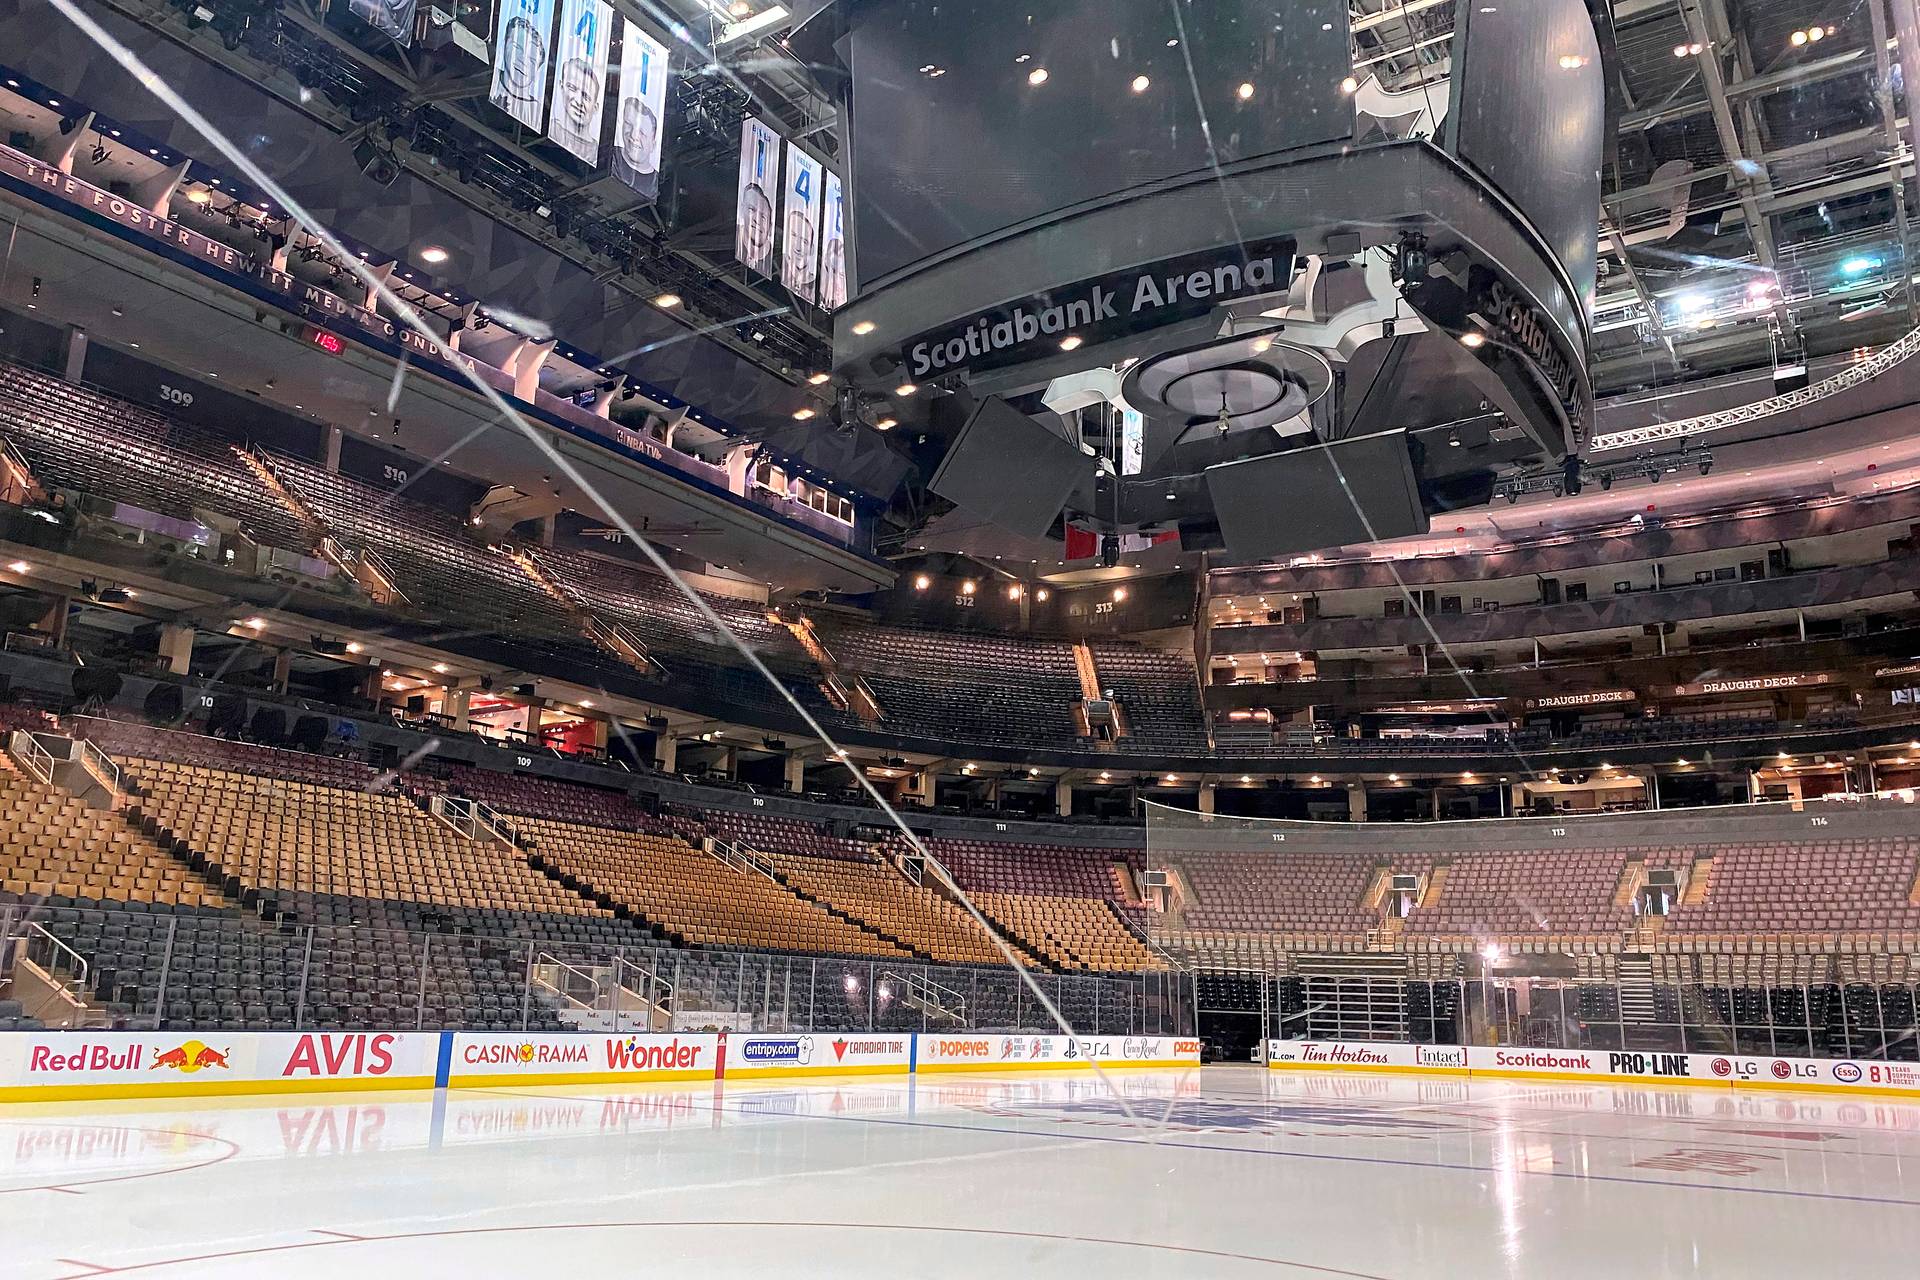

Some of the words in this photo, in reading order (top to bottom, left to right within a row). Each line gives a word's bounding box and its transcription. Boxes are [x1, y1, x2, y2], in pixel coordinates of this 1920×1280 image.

[795, 168, 810, 209] 4
[26, 162, 75, 194] THE
[93, 195, 189, 246] FOSTER
[206, 242, 293, 290] HEWITT
[305, 287, 370, 326] MEDIA
[911, 286, 1118, 376] Scotiabank
[1131, 257, 1274, 313] Arena
[160, 384, 194, 407] 309
[955, 595, 974, 607] 312
[1096, 602, 1113, 614] 313
[1702, 679, 1761, 693] DRAUGHT
[1763, 676, 1798, 688] DECK
[1538, 694, 1590, 707] DRAUGHT
[1592, 691, 1623, 702] DECK
[517, 756, 532, 767] 109
[752, 797, 764, 806] 110
[995, 823, 1006, 831] 111
[1551, 828, 1565, 836] 113
[282, 1033, 394, 1076] AVIS
[538, 1043, 589, 1064] RAMA
[606, 1037, 702, 1069] Wonder
[745, 1043, 797, 1060] entripy.com
[850, 1042, 888, 1054] CANADIAN
[888, 1041, 903, 1053] TIRE
[1080, 1042, 1110, 1056] PS4
[1300, 1044, 1327, 1061] Tim
[1330, 1044, 1388, 1064] Hortons
[30, 1044, 87, 1072] Red
[90, 1044, 142, 1071] Bull
[1496, 1051, 1591, 1069] Scotiabank
[1735, 1061, 1758, 1075] LG
[1794, 1063, 1818, 1077] LG
[1837, 1067, 1858, 1077] Esso
